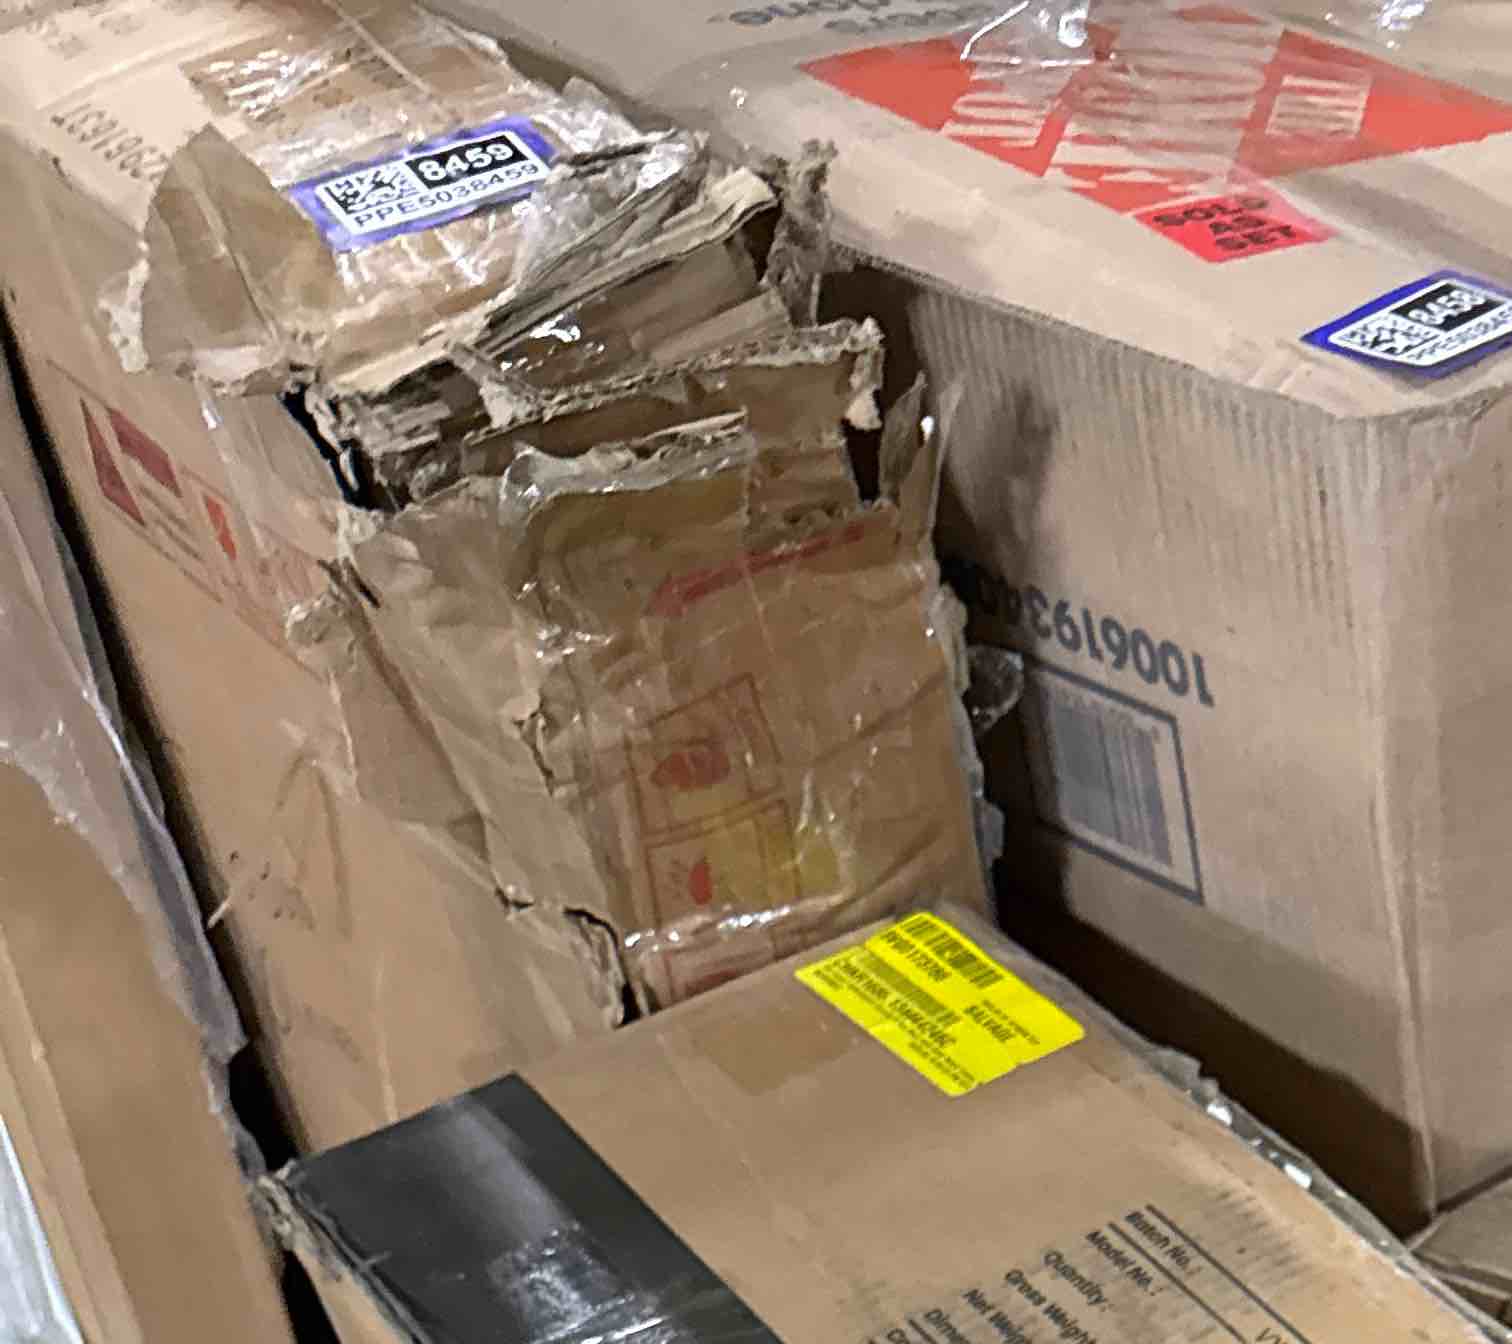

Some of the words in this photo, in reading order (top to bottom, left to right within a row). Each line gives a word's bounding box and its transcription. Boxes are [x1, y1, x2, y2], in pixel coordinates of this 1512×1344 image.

[418, 143, 512, 181] 8459
[353, 163, 539, 228] PPE5038459
[1015, 582, 1214, 707] 1006193
[1083, 1228, 1137, 1270] Model
[960, 1286, 1000, 1315] Net
[999, 1267, 1051, 1308] Gross
